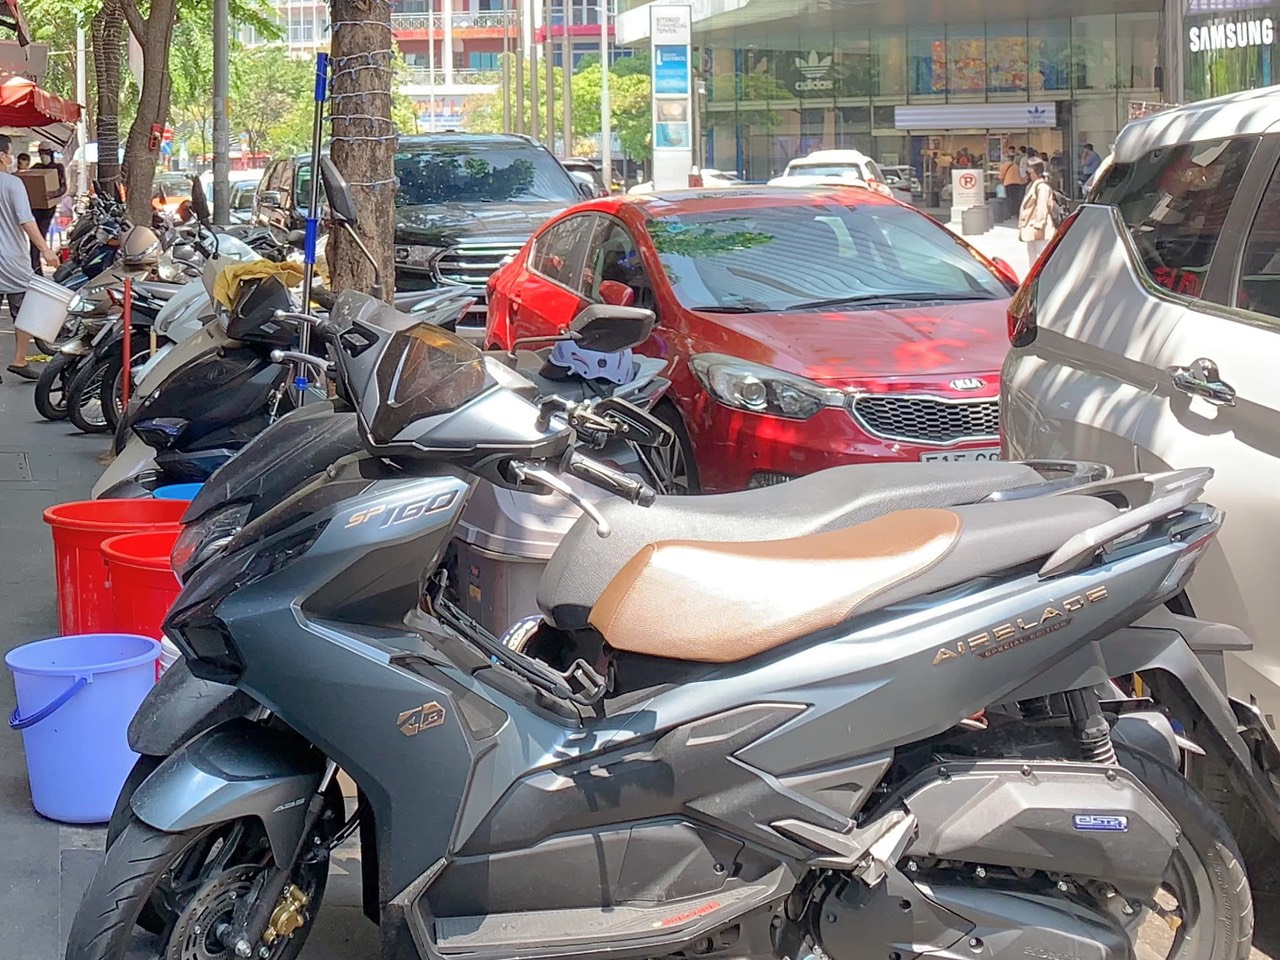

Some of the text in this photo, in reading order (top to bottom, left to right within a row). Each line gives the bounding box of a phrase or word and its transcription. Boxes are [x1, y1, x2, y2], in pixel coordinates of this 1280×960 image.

[1189, 18, 1274, 53] SAMSUNG
[794, 79, 833, 91] adidas
[953, 377, 983, 389] KIA
